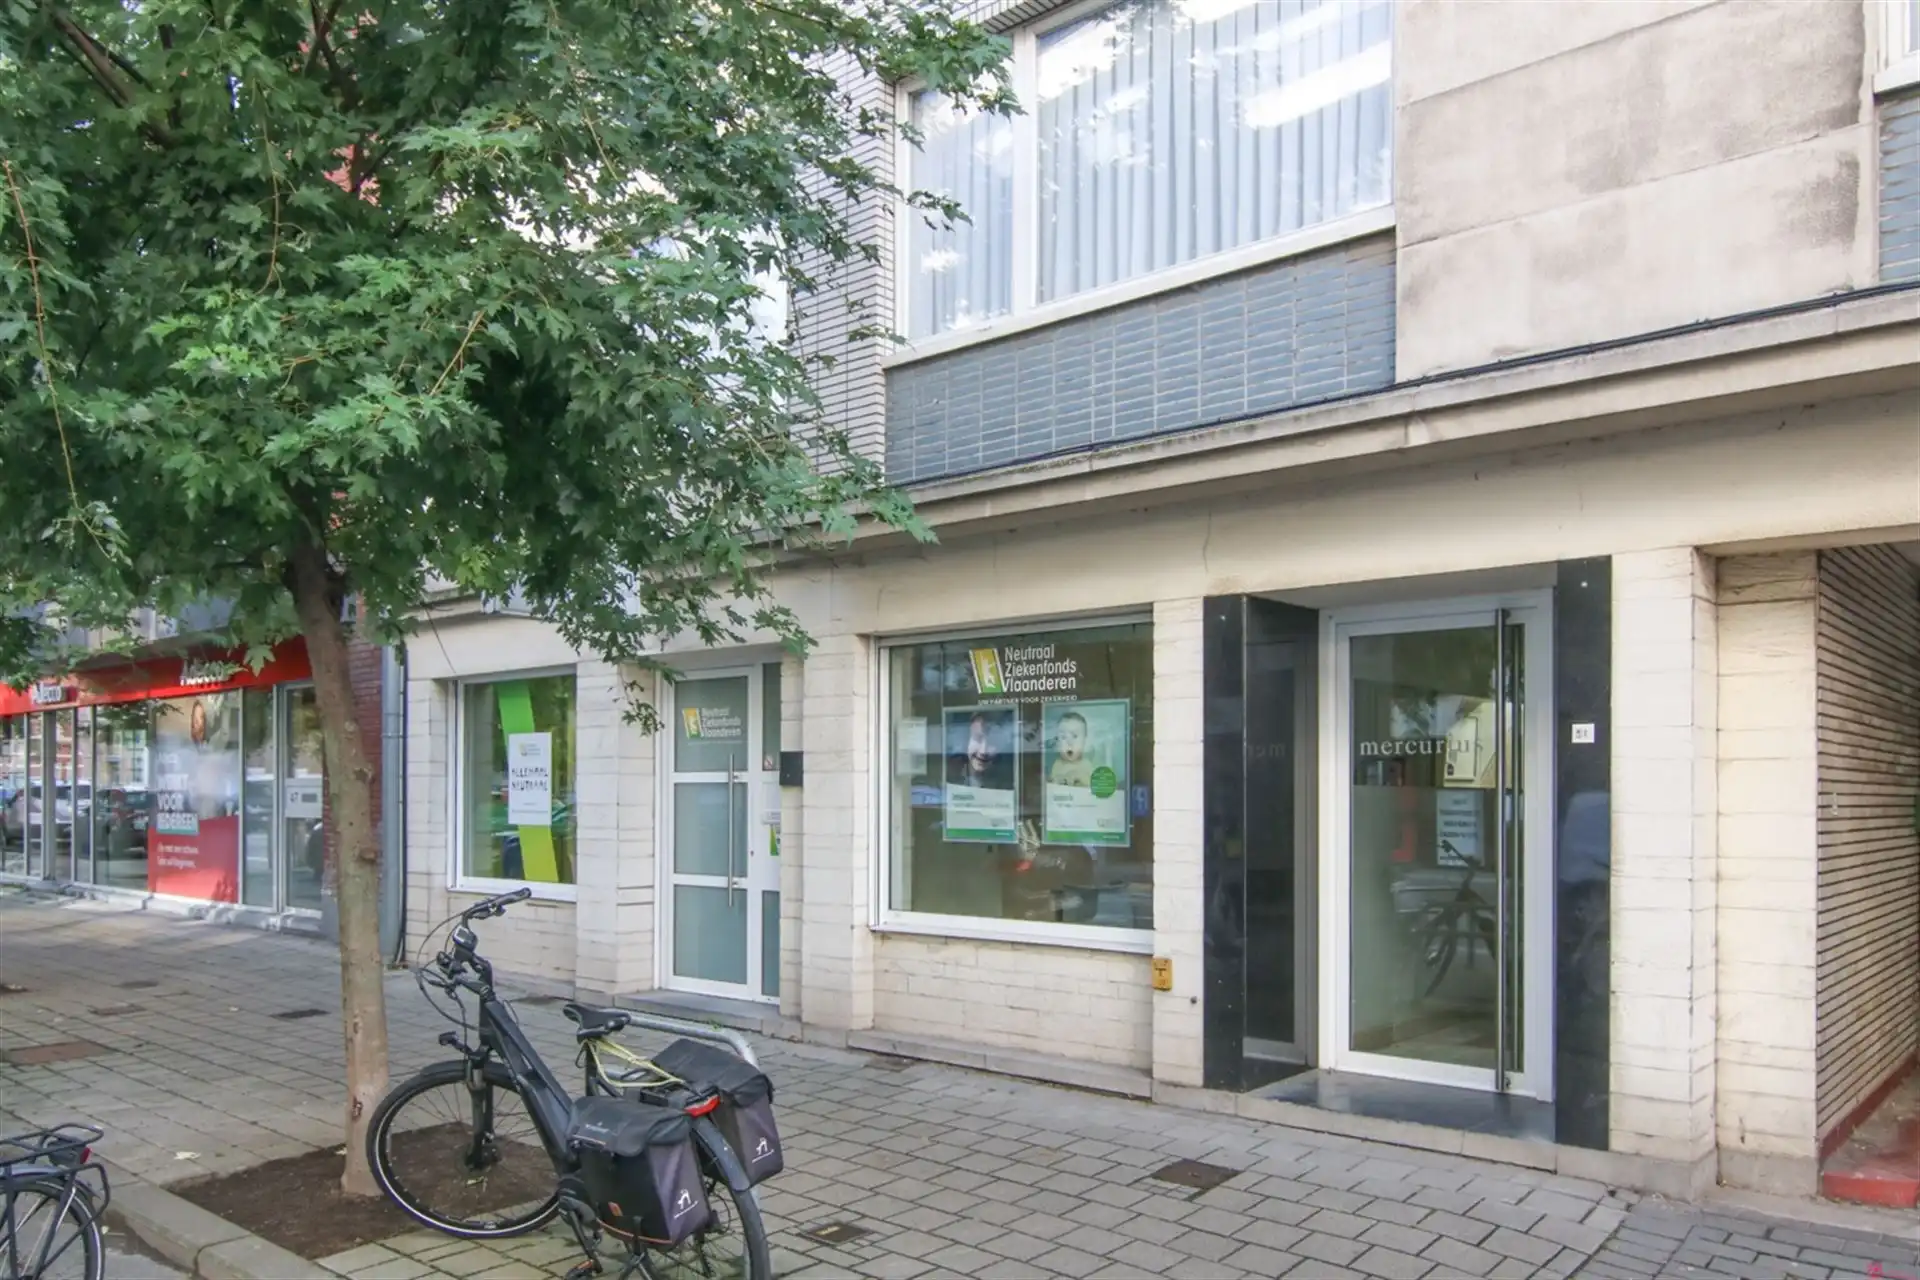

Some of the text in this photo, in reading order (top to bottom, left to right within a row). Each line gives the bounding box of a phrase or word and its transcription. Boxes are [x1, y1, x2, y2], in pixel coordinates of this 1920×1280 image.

[1004, 644, 1054, 661] Neutraal
[1004, 658, 1077, 677] Ziekenfonds
[1003, 676, 1076, 692] Vlaanderen
[1359, 732, 1484, 756] mercurius
